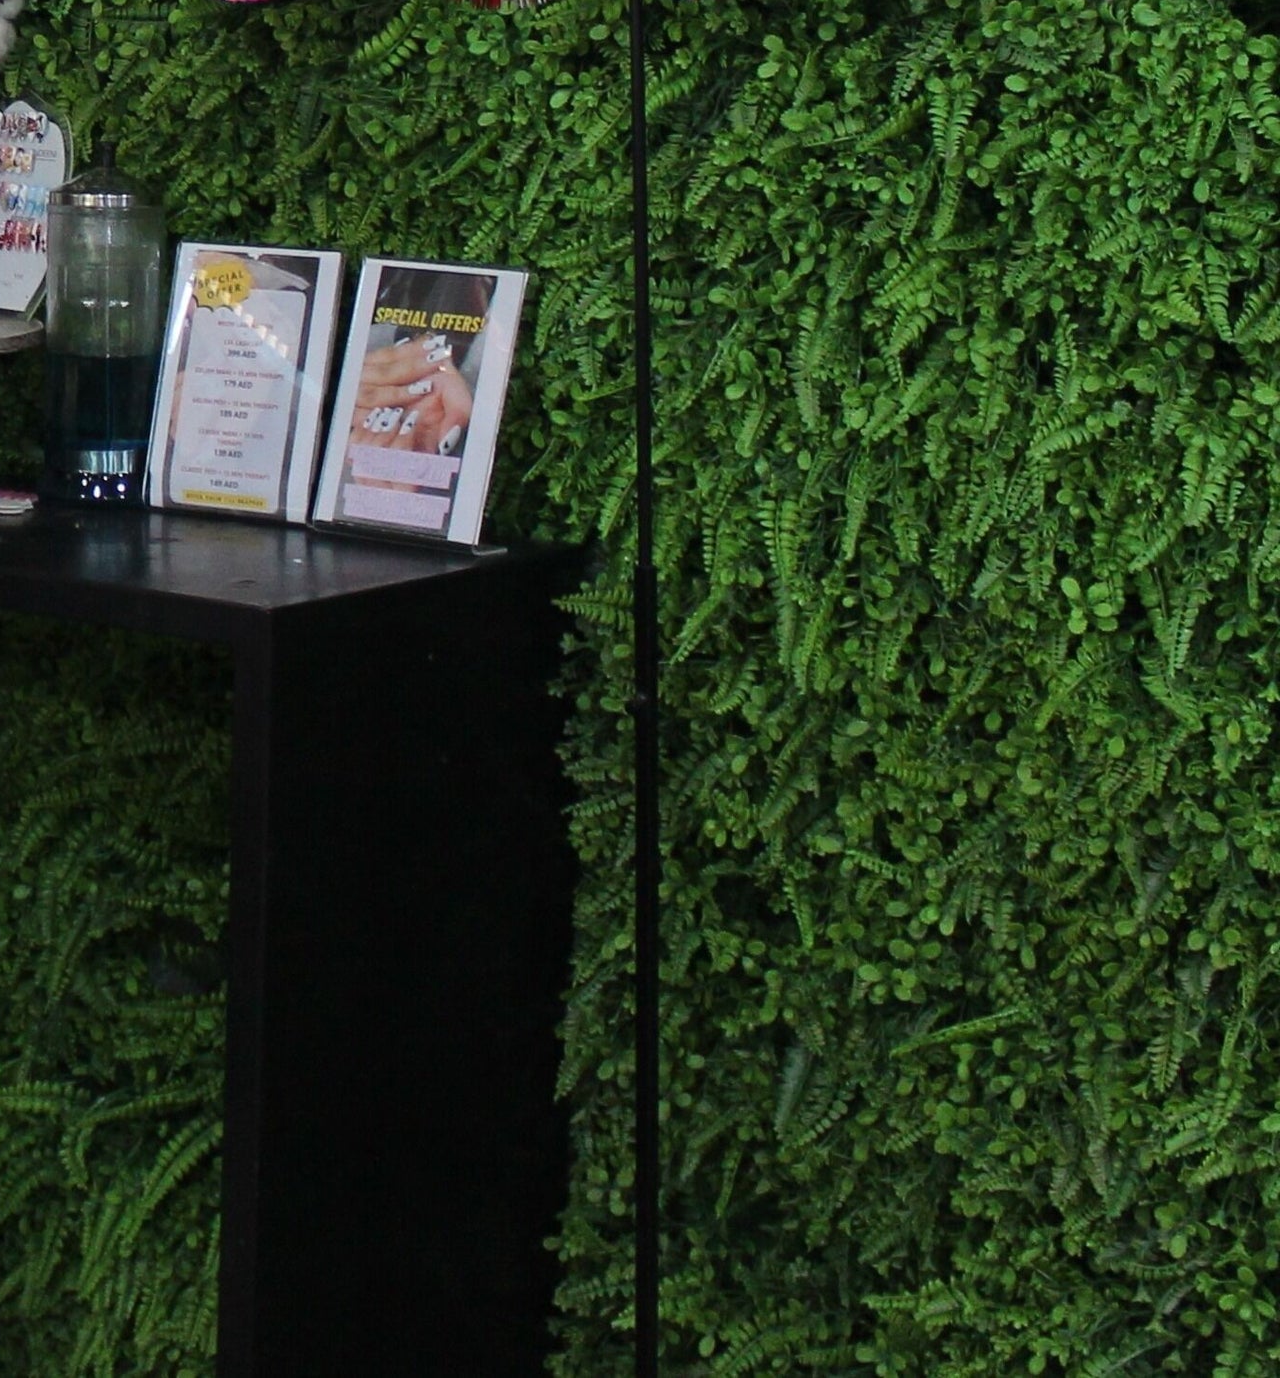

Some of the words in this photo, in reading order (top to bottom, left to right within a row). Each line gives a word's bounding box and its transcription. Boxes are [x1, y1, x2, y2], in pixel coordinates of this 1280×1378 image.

[197, 270, 244, 289] SPECIAL
[374, 307, 428, 328] SPECIAL
[431, 313, 486, 333] OFFERS!
[238, 381, 253, 389] AED
[234, 410, 248, 419] AED
[228, 450, 243, 458] AED
[224, 481, 239, 489] AED
